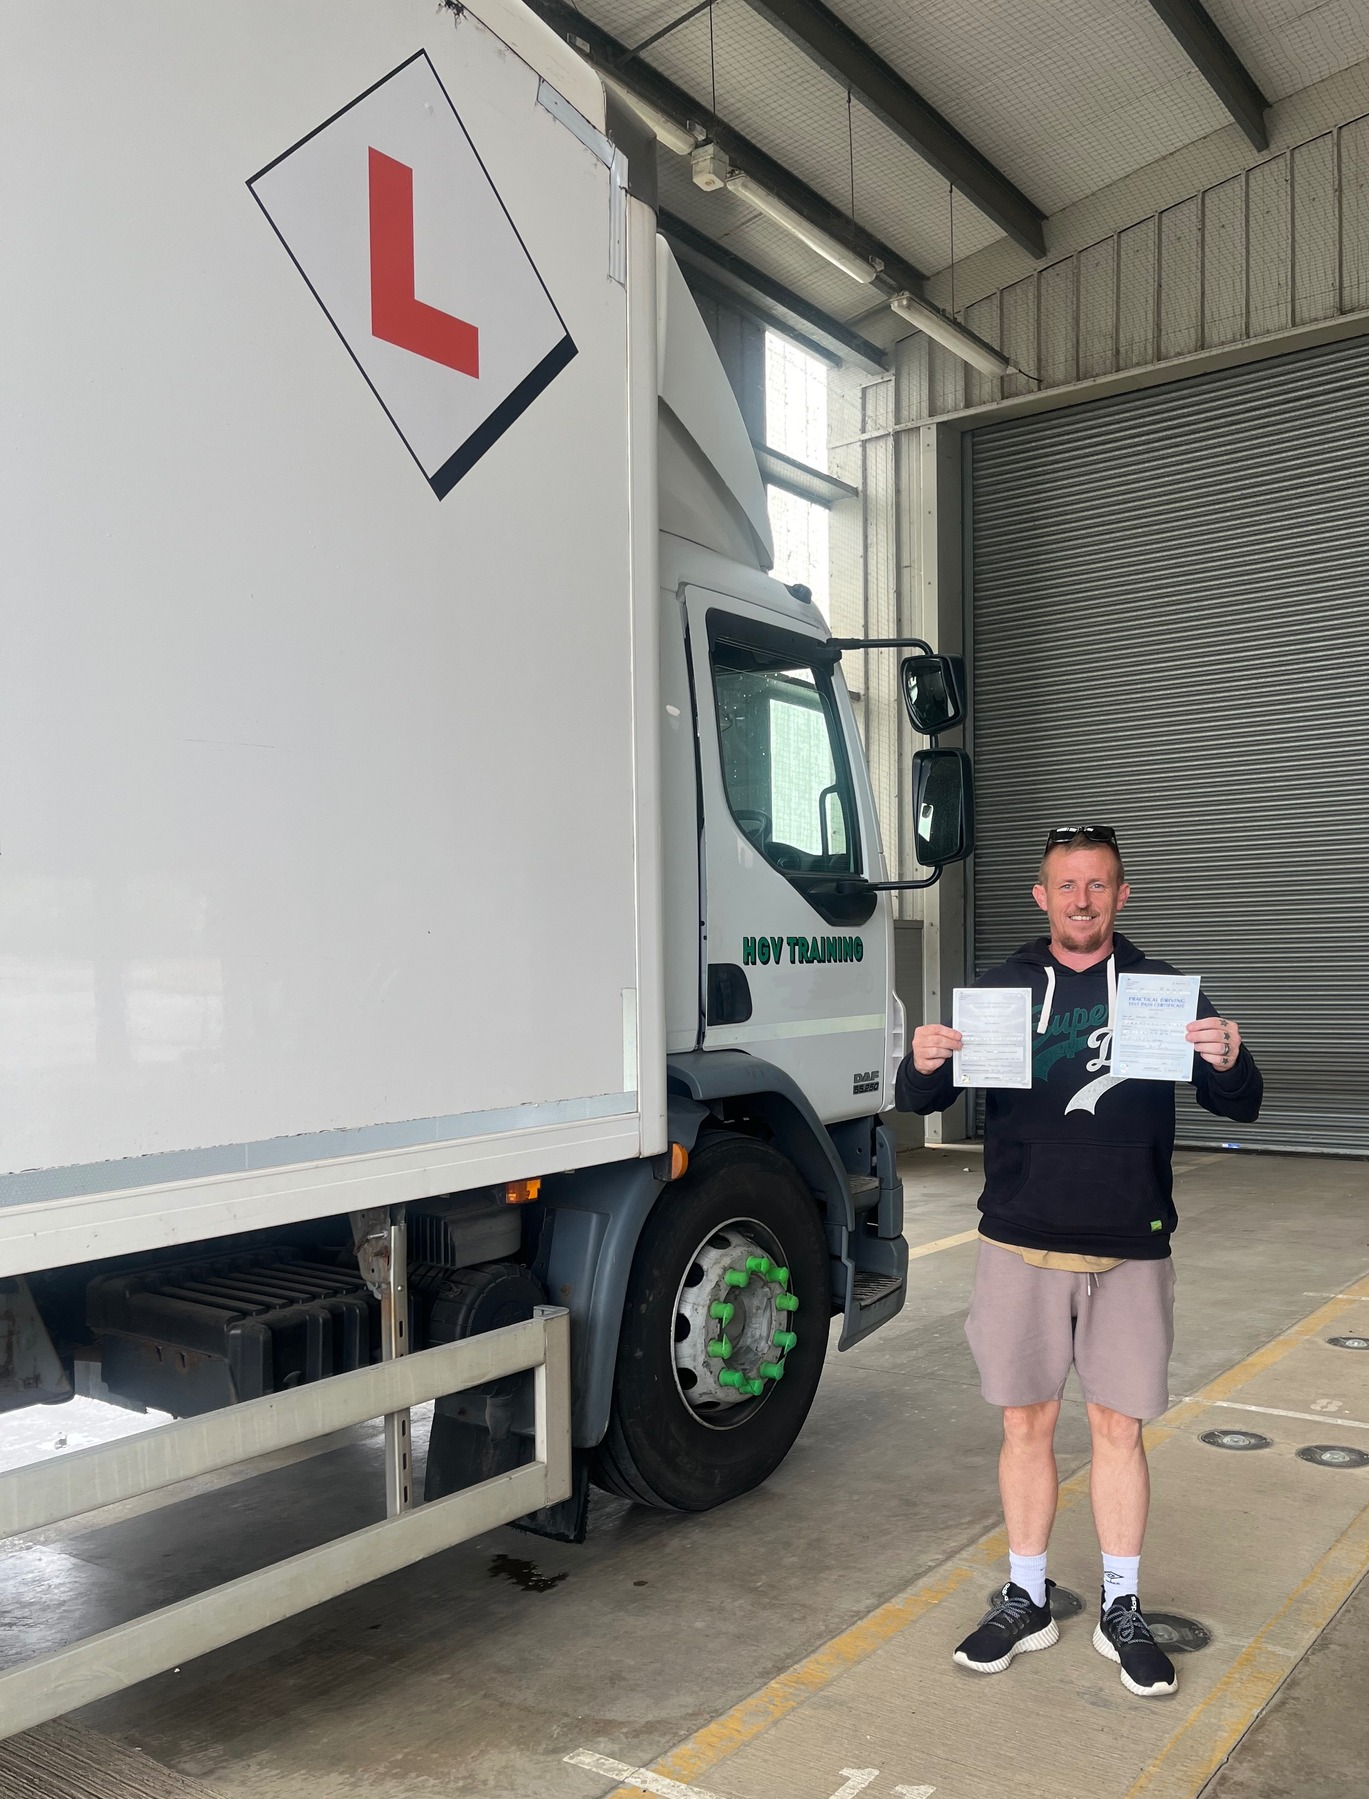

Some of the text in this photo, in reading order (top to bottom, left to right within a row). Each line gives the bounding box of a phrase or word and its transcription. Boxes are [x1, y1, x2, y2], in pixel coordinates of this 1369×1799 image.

[368, 145, 480, 380] L
[742, 936, 864, 965] HGV TRAINING
[853, 1070, 880, 1084] DAF
